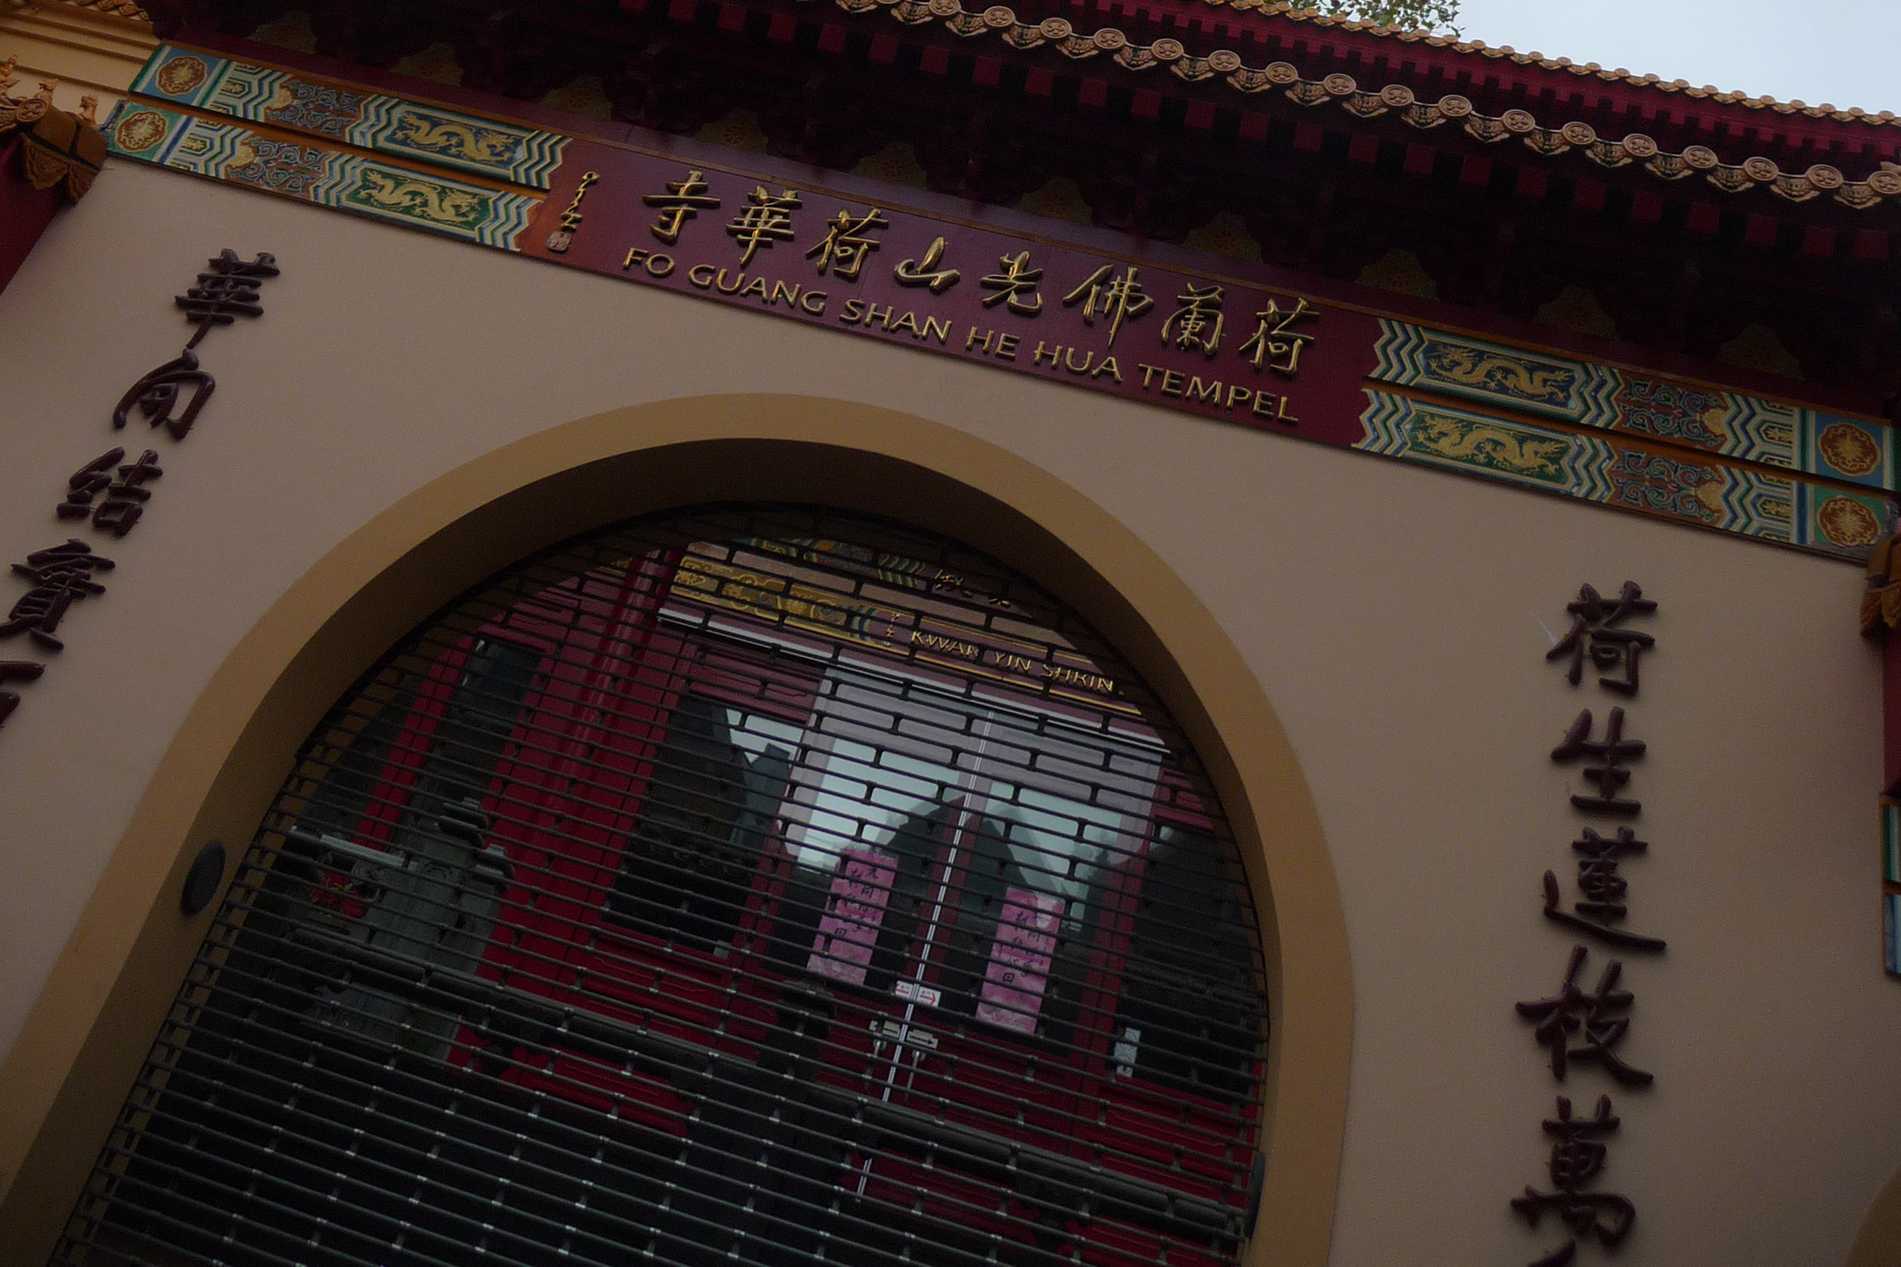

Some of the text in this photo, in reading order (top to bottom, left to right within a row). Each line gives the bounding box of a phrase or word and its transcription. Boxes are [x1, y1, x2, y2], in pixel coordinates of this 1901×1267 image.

[622, 247, 1299, 425] FO GUANG SHAN HE HUA TEMPEL
[994, 650, 1032, 673] YIN
[1510, 580, 1666, 1267] 荷生蓮枝萬
